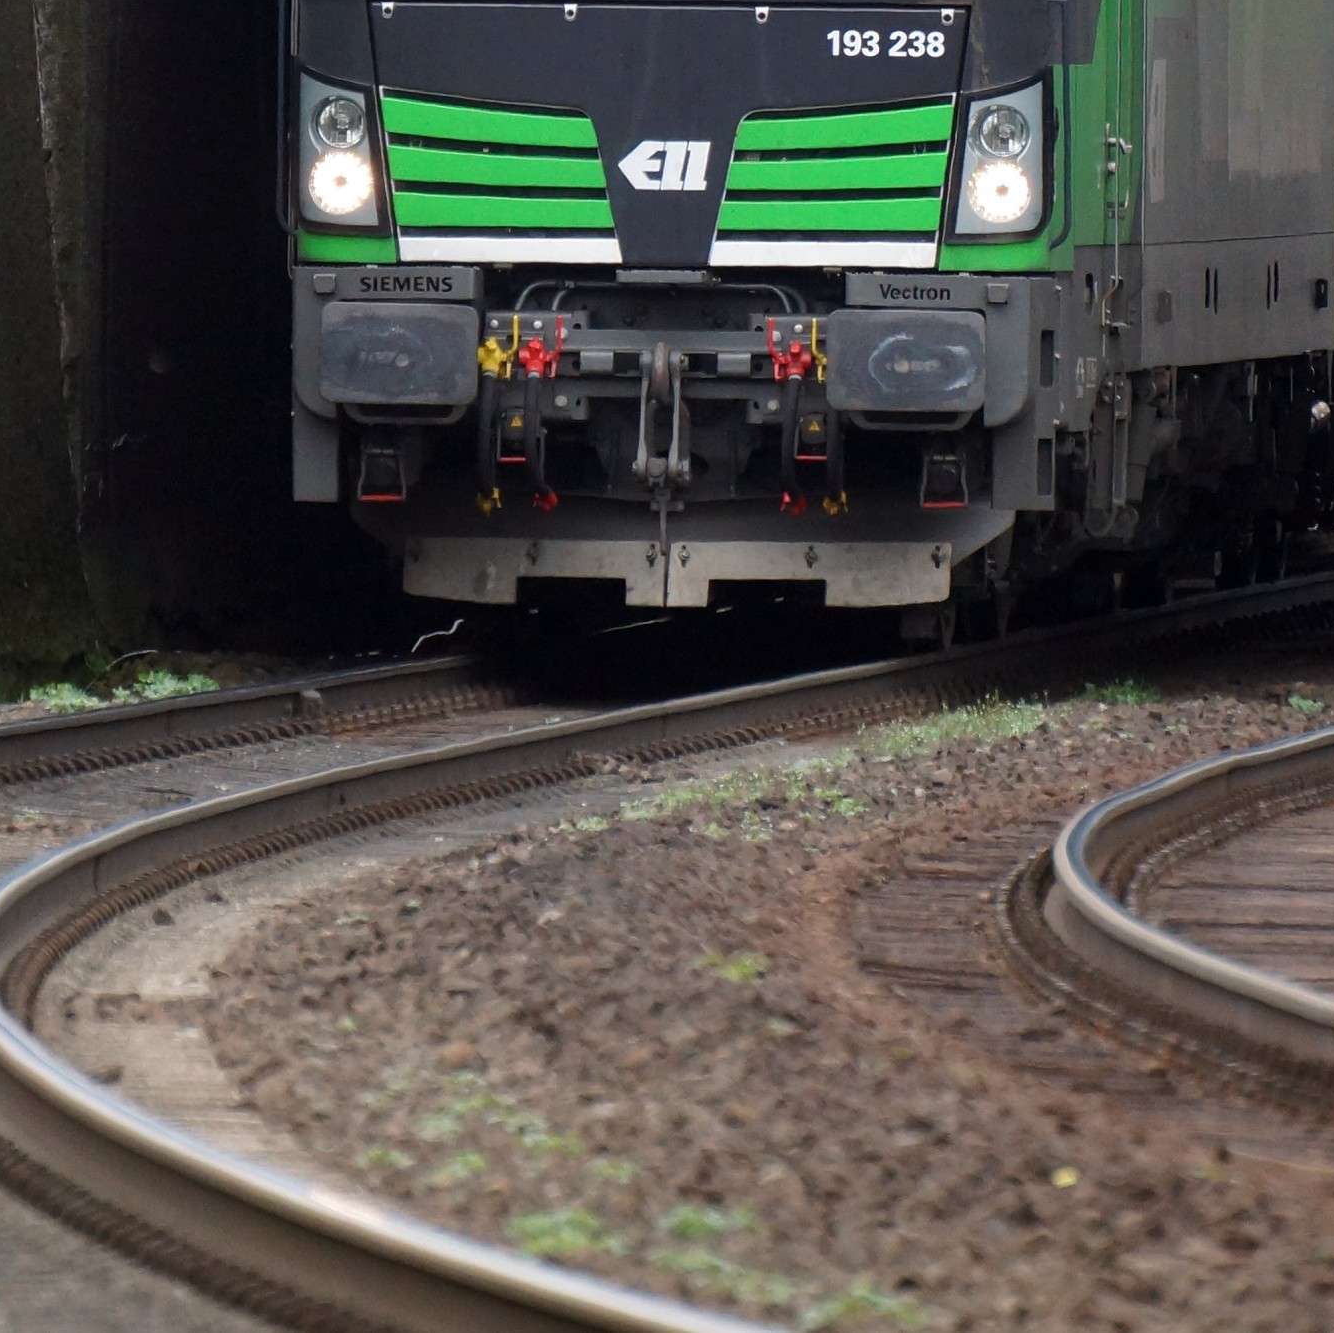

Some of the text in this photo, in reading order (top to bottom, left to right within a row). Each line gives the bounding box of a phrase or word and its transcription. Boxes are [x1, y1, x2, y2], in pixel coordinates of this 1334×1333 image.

[827, 30, 945, 58] 193 238
[359, 276, 453, 293] SIEMENS
[879, 283, 951, 301] Vectron
